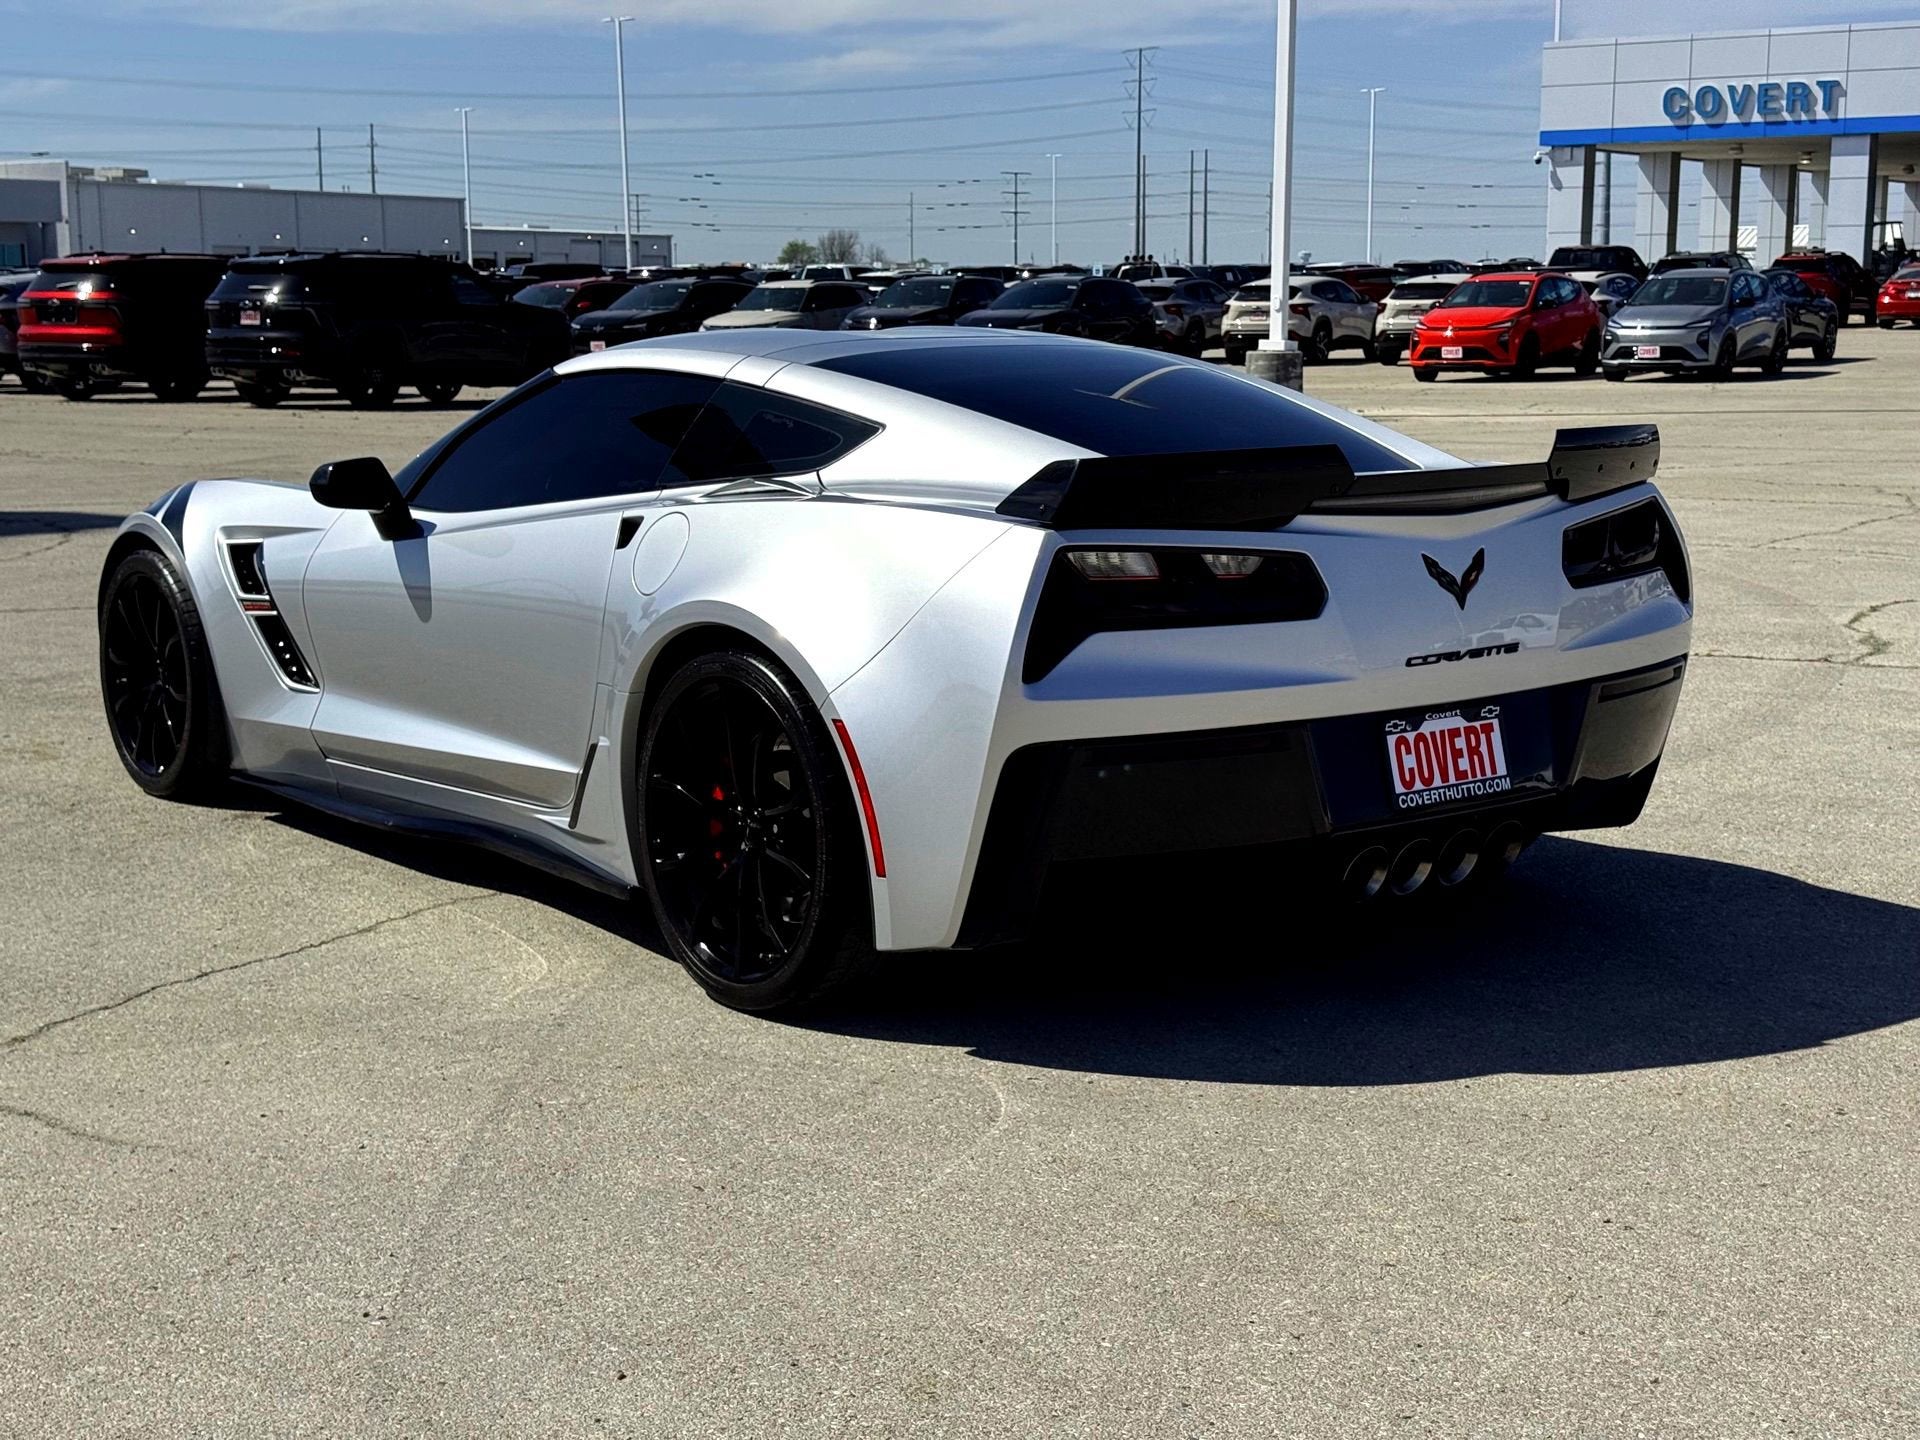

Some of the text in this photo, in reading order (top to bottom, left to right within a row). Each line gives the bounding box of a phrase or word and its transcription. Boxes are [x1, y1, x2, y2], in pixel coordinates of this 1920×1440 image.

[1662, 79, 1844, 121] COVERT
[1405, 642, 1520, 667] CORVETTE
[1425, 709, 1461, 720] Covert
[1394, 722, 1497, 790] COVERT
[1398, 777, 1512, 808] COVERTHUTTO.COM
